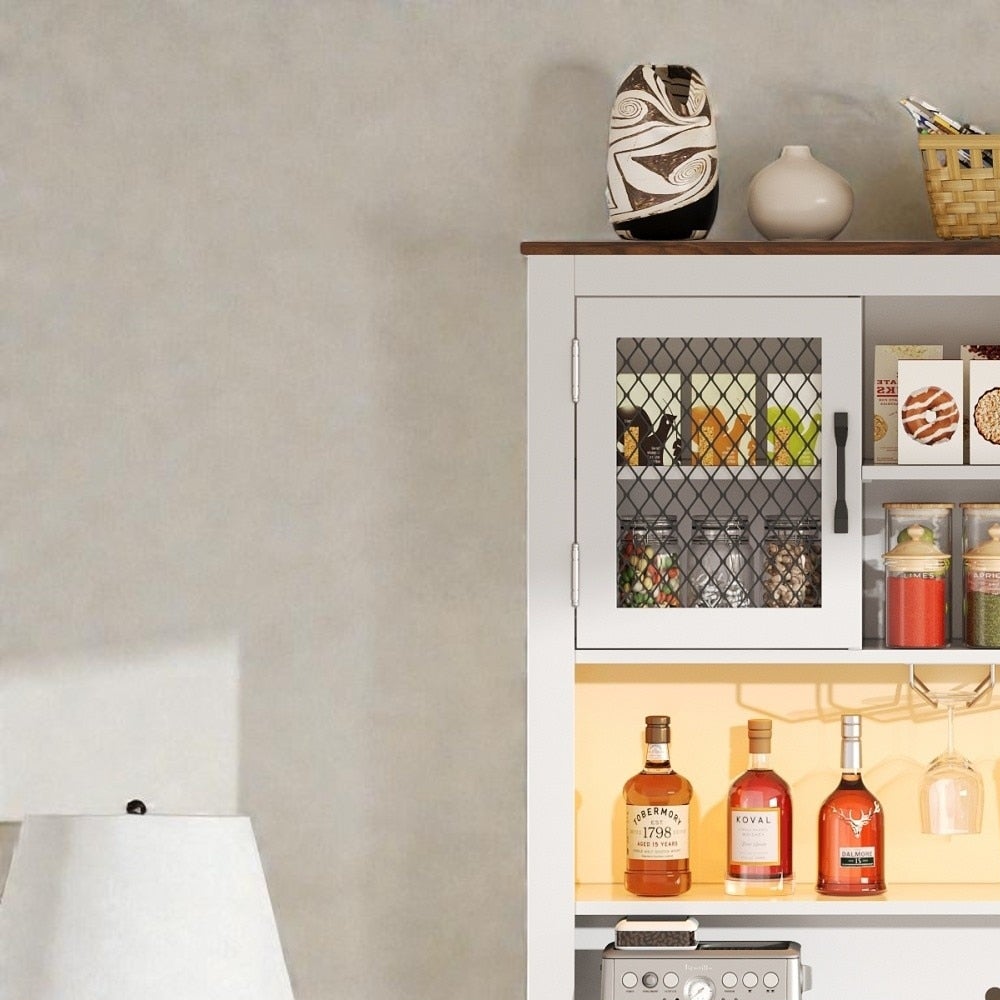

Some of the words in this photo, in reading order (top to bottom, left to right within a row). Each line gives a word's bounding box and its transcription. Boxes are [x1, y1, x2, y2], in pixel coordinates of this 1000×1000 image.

[633, 807, 682, 826] TOBERMORY
[736, 816, 771, 824] KOVAL
[643, 826, 672, 839] 1798
